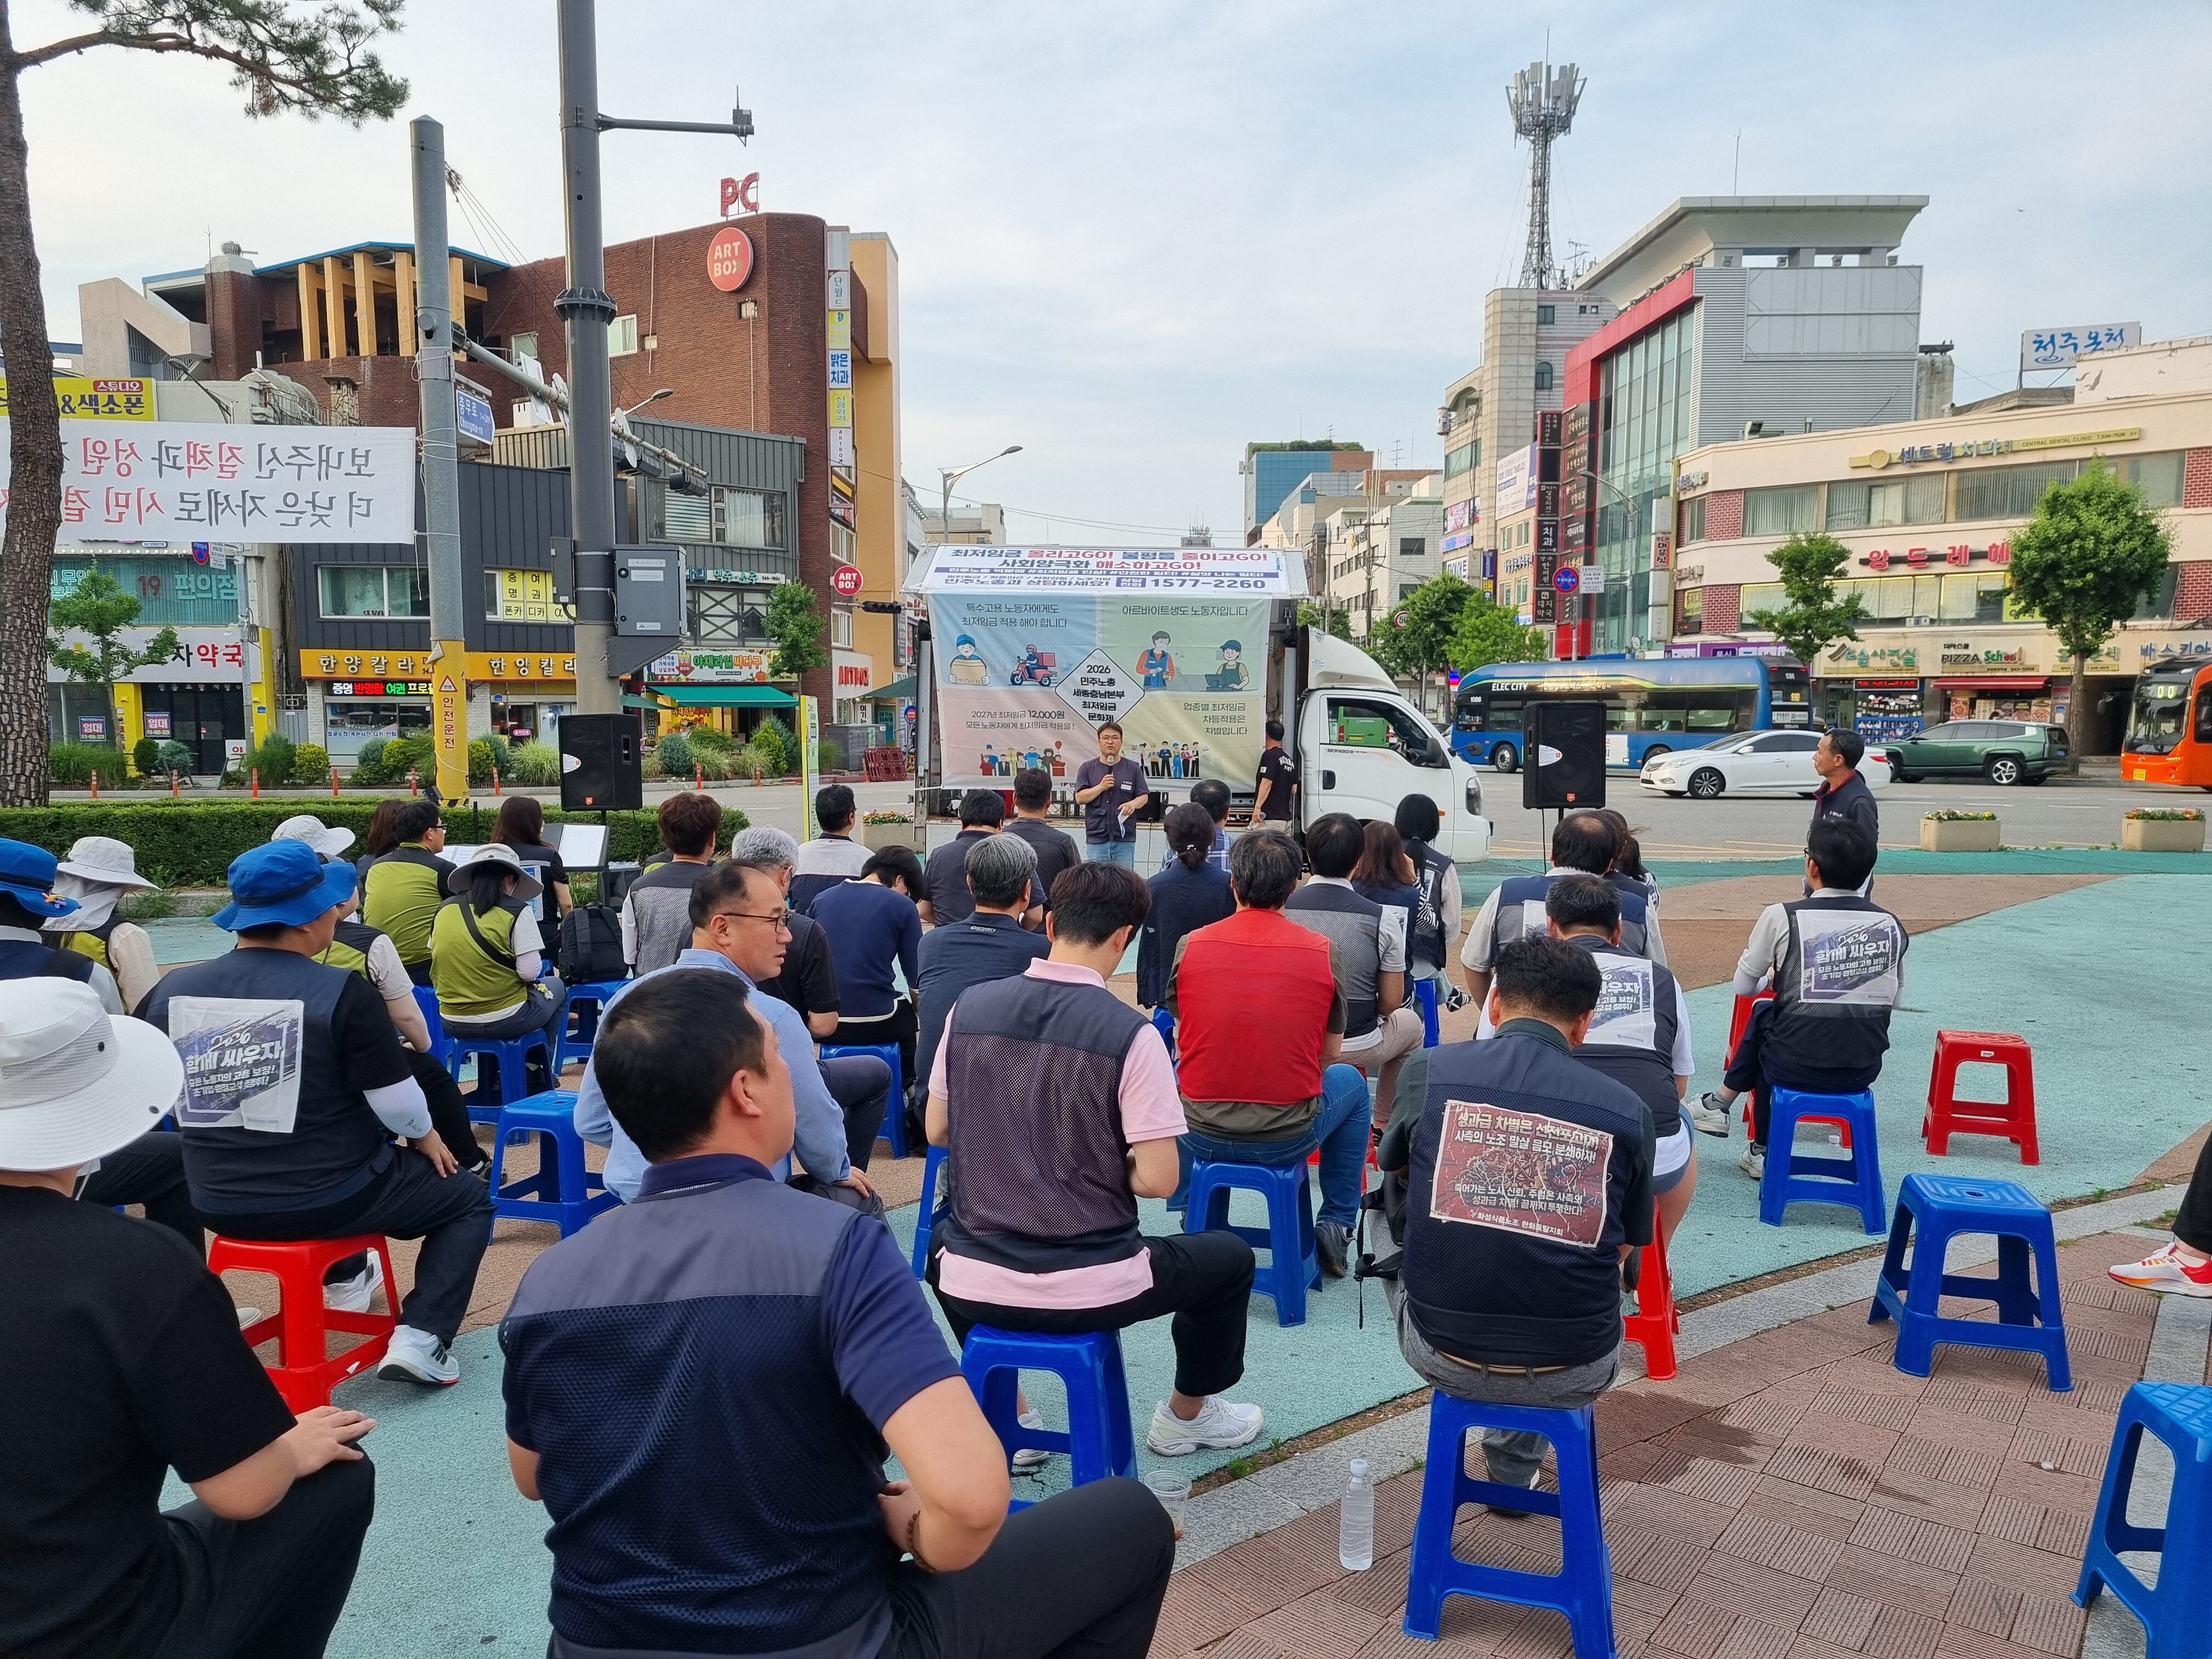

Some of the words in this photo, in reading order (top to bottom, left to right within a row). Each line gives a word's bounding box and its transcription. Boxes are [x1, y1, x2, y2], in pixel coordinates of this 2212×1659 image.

[721, 172, 759, 216] PC
[714, 241, 741, 259] ART
[714, 258, 742, 277] BOX
[834, 276, 843, 307] 단월드
[830, 353, 848, 368] 밝은
[831, 370, 849, 384] 치과
[97, 381, 141, 392] 스튜디오
[459, 395, 478, 417] 충무로
[2049, 437, 2072, 445] DENTAL
[1897, 442, 1954, 466] 센트럴
[1959, 438, 2001, 459] 치과
[1542, 527, 1554, 546] 치과
[951, 549, 1022, 558] 최저임금
[1027, 550, 1114, 559] 올리고GO!
[1122, 551, 1175, 561] 불평등
[1181, 552, 1268, 561] 줄이고GO!
[1868, 542, 2012, 570] 앙드레헤
[997, 558, 1091, 568] 사회양극화
[1095, 560, 1201, 569] 해소하고GO!
[838, 573, 857, 581] ART
[138, 574, 161, 597] 19
[174, 572, 238, 600] 편의점
[507, 572, 517, 599] 증명
[531, 573, 541, 600] 여권
[838, 581, 859, 589] BOX
[1150, 578, 1266, 590] 1577-2260
[504, 605, 522, 616] 폰카
[966, 602, 1003, 613] 특수고용
[1005, 603, 1059, 614] 노동자에게도
[1537, 600, 1553, 608] 대지
[528, 606, 545, 618] 디카
[1122, 605, 1188, 617] 아르바이트생도
[1190, 605, 1249, 617] 노동자입니다
[961, 617, 998, 627] 최저임금
[1000, 618, 1018, 628] 적용
[1019, 618, 1039, 628] 해야
[1040, 618, 1068, 628] 합니다
[319, 654, 415, 675] 한양칼라
[1941, 653, 1981, 664] PIZZA
[838, 665, 869, 686] ARTBOX
[1086, 664, 1111, 674] 2026
[1080, 676, 1116, 687] 민주노총
[1492, 682, 1510, 692] ELEC
[1511, 681, 1528, 691] CITY
[332, 682, 353, 695] 증명
[386, 682, 407, 695] 여권
[1073, 689, 1126, 699] 세종충남본부
[1081, 701, 1117, 712] 최저임금
[1183, 702, 1210, 712] 업종별
[1210, 702, 1246, 712] 최저임금
[971, 710, 997, 719] 2027년
[998, 710, 1026, 719] 최저임금
[1027, 709, 1065, 720] 12,000원
[1087, 713, 1115, 724] 문화제
[1202, 714, 1246, 724] 차등적용은
[83, 723, 103, 733] 임대
[148, 718, 167, 729] 임대
[443, 697, 455, 749] 안전운전
[966, 721, 980, 729] 모든
[981, 721, 1018, 730] 노동자에게
[1019, 721, 1048, 730] 최저임금
[1204, 726, 1249, 736] 차별입니다
[1837, 930, 1869, 949] 2026
[1815, 946, 1847, 964] 함께
[1848, 939, 1891, 958] 싸우자
[1818, 965, 1832, 974] 모든
[1832, 961, 1859, 972] 노동자의
[1859, 959, 1872, 967] 고용
[1872, 957, 1887, 966] 보장!
[1618, 996, 1637, 1004] 보장!
[208, 1027, 252, 1053] 2026
[185, 1051, 219, 1075] 함께
[220, 1040, 283, 1068] 싸우자
[203, 1072, 232, 1085] 노동자의
[233, 1070, 252, 1080] 고용
[252, 1064, 276, 1076] 보장!
[1457, 1111, 1493, 1129] 성과급
[1495, 1115, 1534, 1134] 차별은
[1454, 1129, 1484, 1145] 사측의
[1485, 1132, 1506, 1147] 노조
[1508, 1136, 1531, 1150] 말살
[1555, 1144, 1597, 1165] 분쇄하자!
[1453, 1183, 1487, 1195] 죽어가는
[1487, 1184, 1504, 1196] 노사
[1506, 1185, 1526, 1199] 신뢰,
[1528, 1188, 1556, 1202] 주범은
[1556, 1192, 1584, 1206] 사측의
[1472, 1195, 1498, 1207] 성과급
[1498, 1197, 1520, 1209] 차별!
[1520, 1199, 1548, 1212] 끝까지
[1547, 1202, 1584, 1217] 투쟁한다!
[1477, 1211, 1520, 1227] 화섬식품노조
[1521, 1220, 1564, 1237] 한화토탈지회
